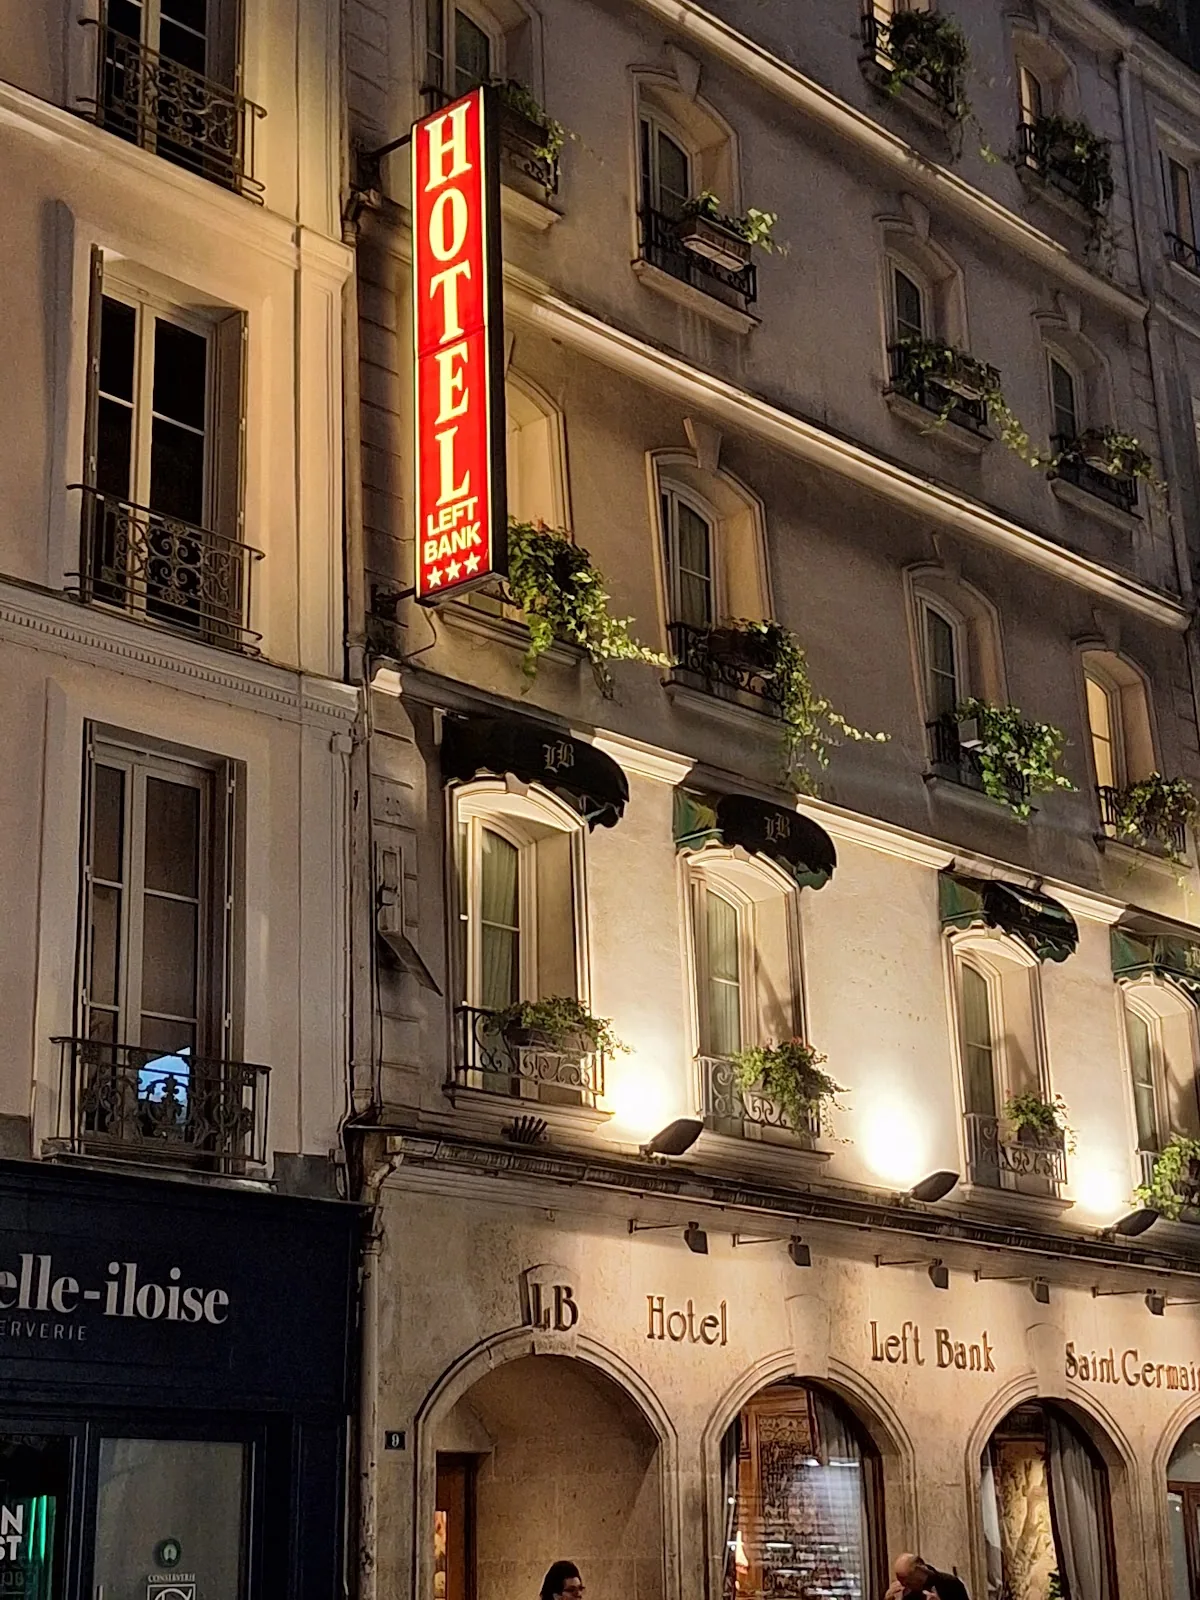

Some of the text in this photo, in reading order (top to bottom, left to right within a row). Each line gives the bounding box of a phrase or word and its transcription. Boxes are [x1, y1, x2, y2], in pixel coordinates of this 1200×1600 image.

[424, 101, 473, 506] HOTEL
[427, 496, 479, 538] LEFT
[424, 521, 482, 564] BANK
[530, 1283, 579, 1332] LB
[646, 1295, 728, 1347] Hotel
[869, 1320, 926, 1366] Left
[934, 1328, 996, 1373] Bank
[1065, 1341, 1120, 1384] Saint
[391, 1433, 400, 1448] 9
